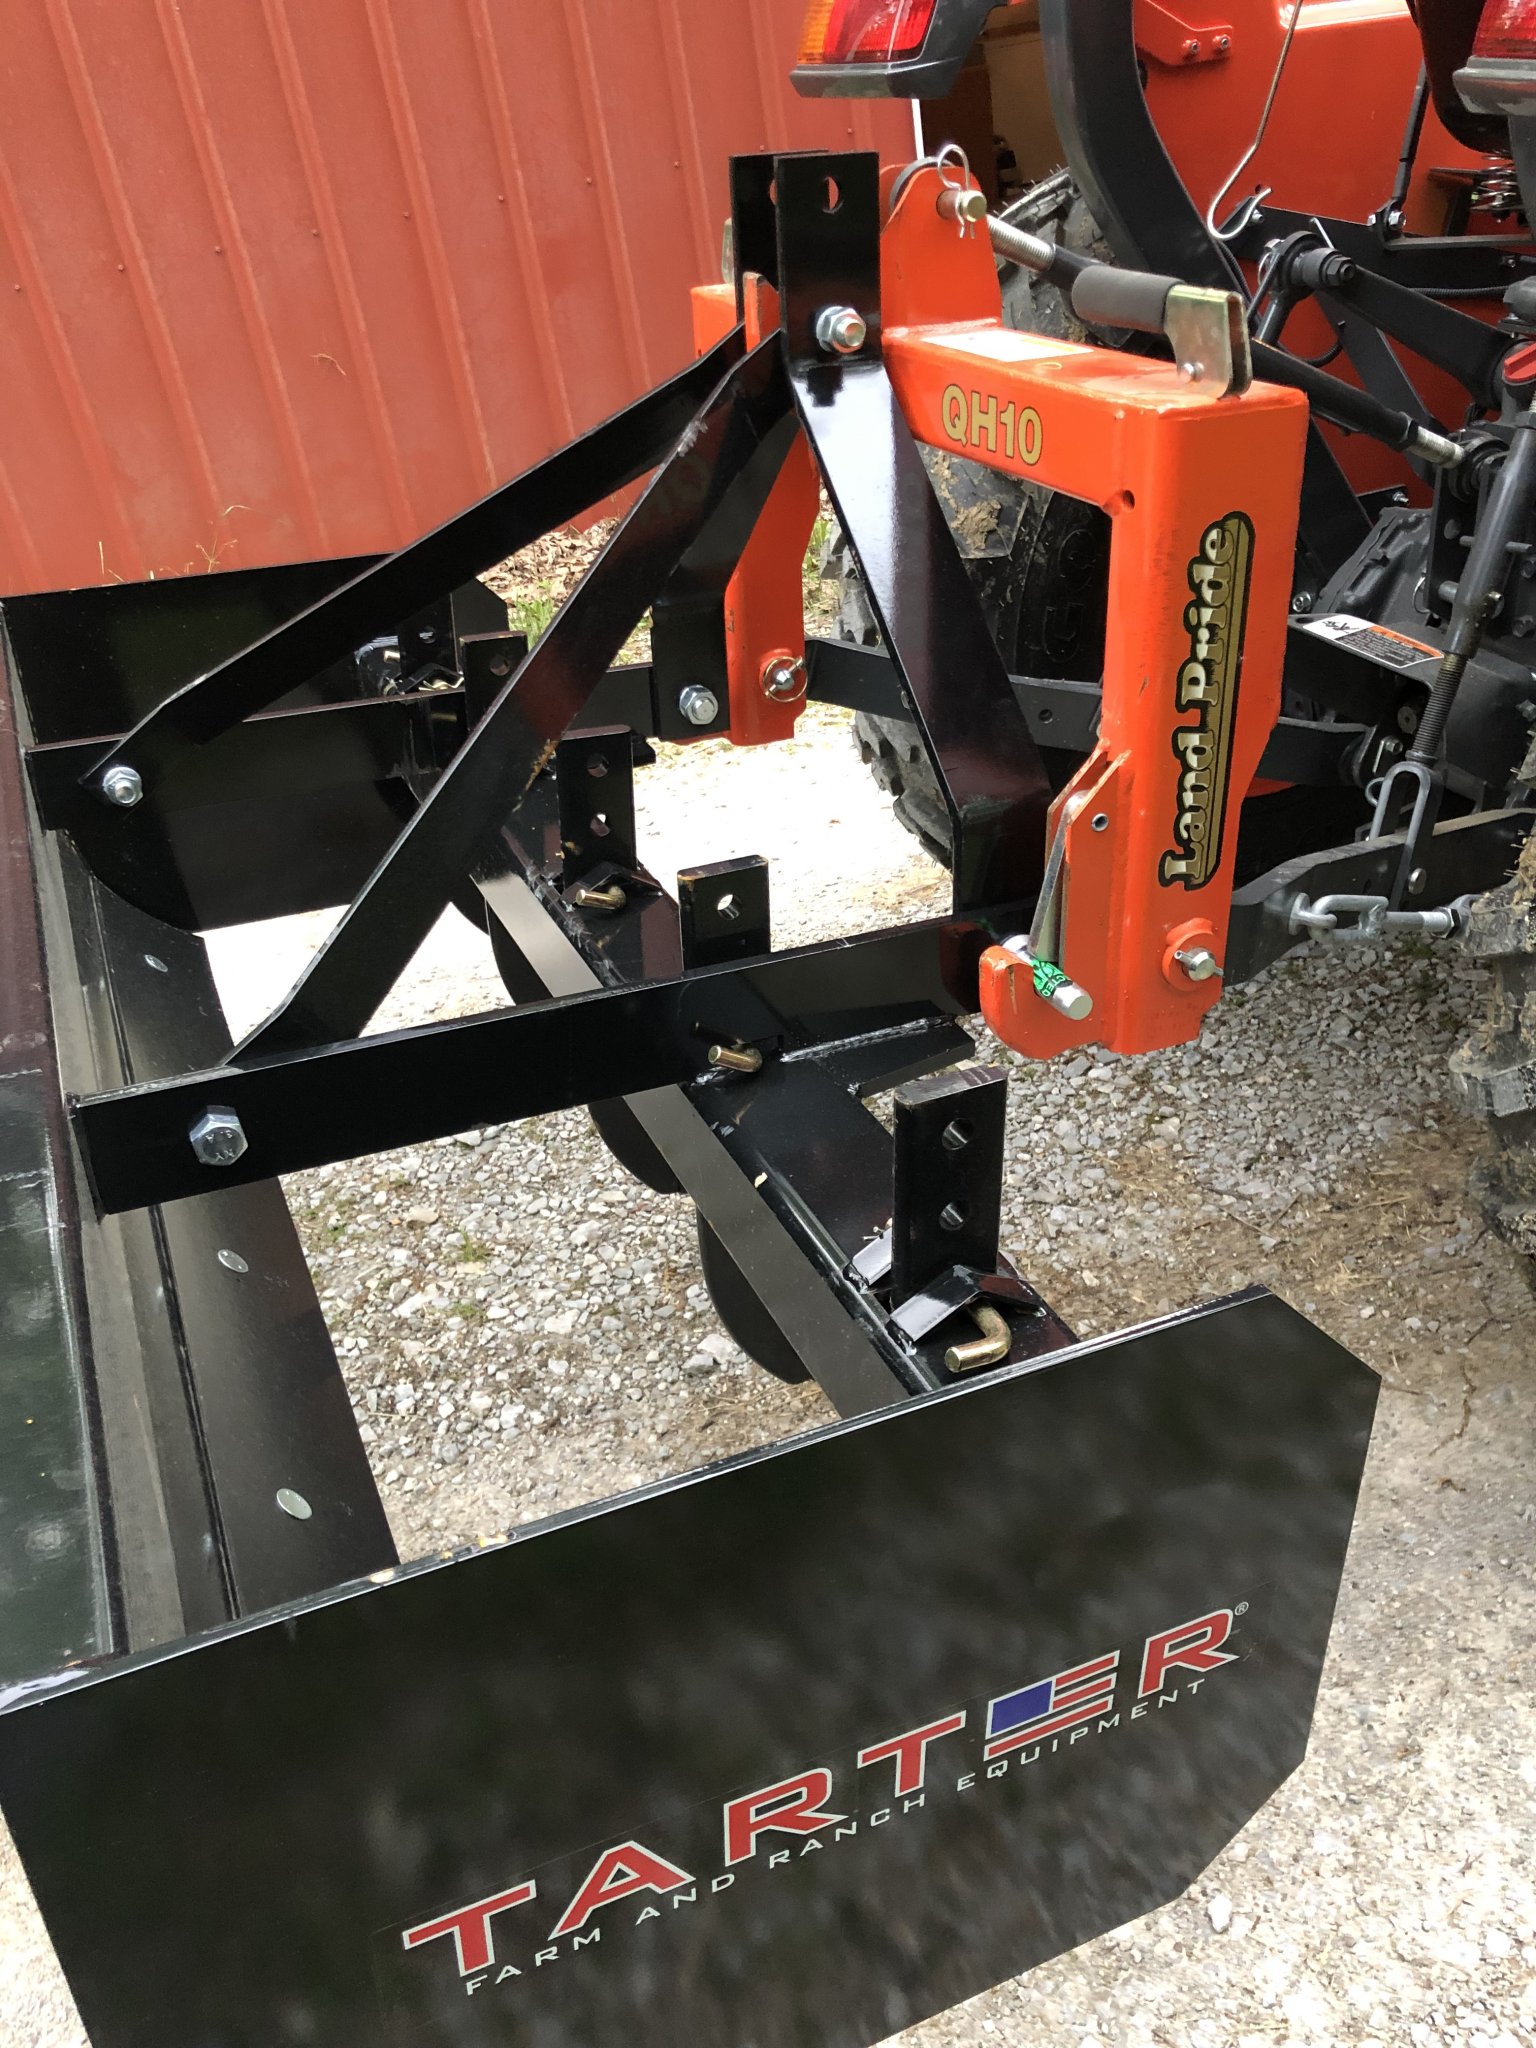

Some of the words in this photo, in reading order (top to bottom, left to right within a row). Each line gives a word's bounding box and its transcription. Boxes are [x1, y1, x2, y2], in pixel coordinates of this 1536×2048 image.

[941, 383, 1043, 466] QH10
[1181, 527, 1234, 706] Pride
[1164, 731, 1214, 880] Land
[465, 1928, 601, 1996] FARM
[635, 1873, 736, 1925] AND
[769, 1794, 927, 1869] RANCH
[956, 1679, 1206, 1792] EQUIPMENT
